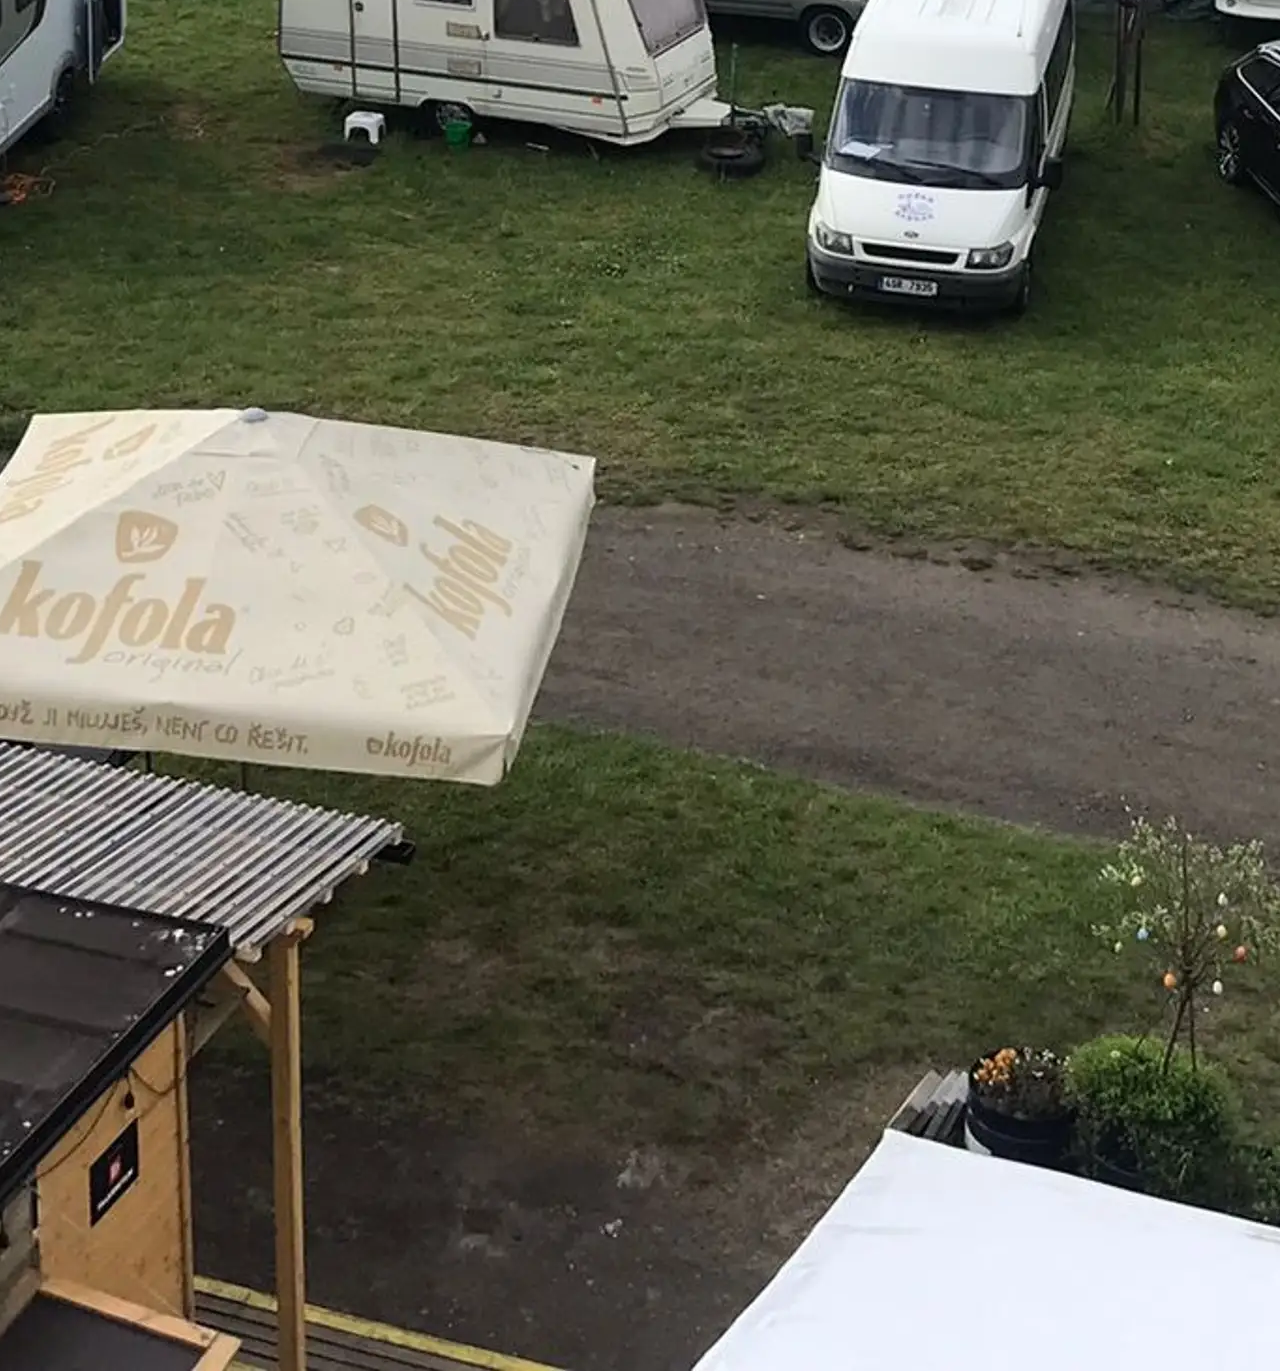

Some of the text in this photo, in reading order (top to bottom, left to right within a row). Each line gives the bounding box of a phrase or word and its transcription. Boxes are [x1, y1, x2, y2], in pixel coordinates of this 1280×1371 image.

[403, 514, 513, 641] kofola
[102, 647, 246, 683] original
[383, 730, 452, 767] kofola
